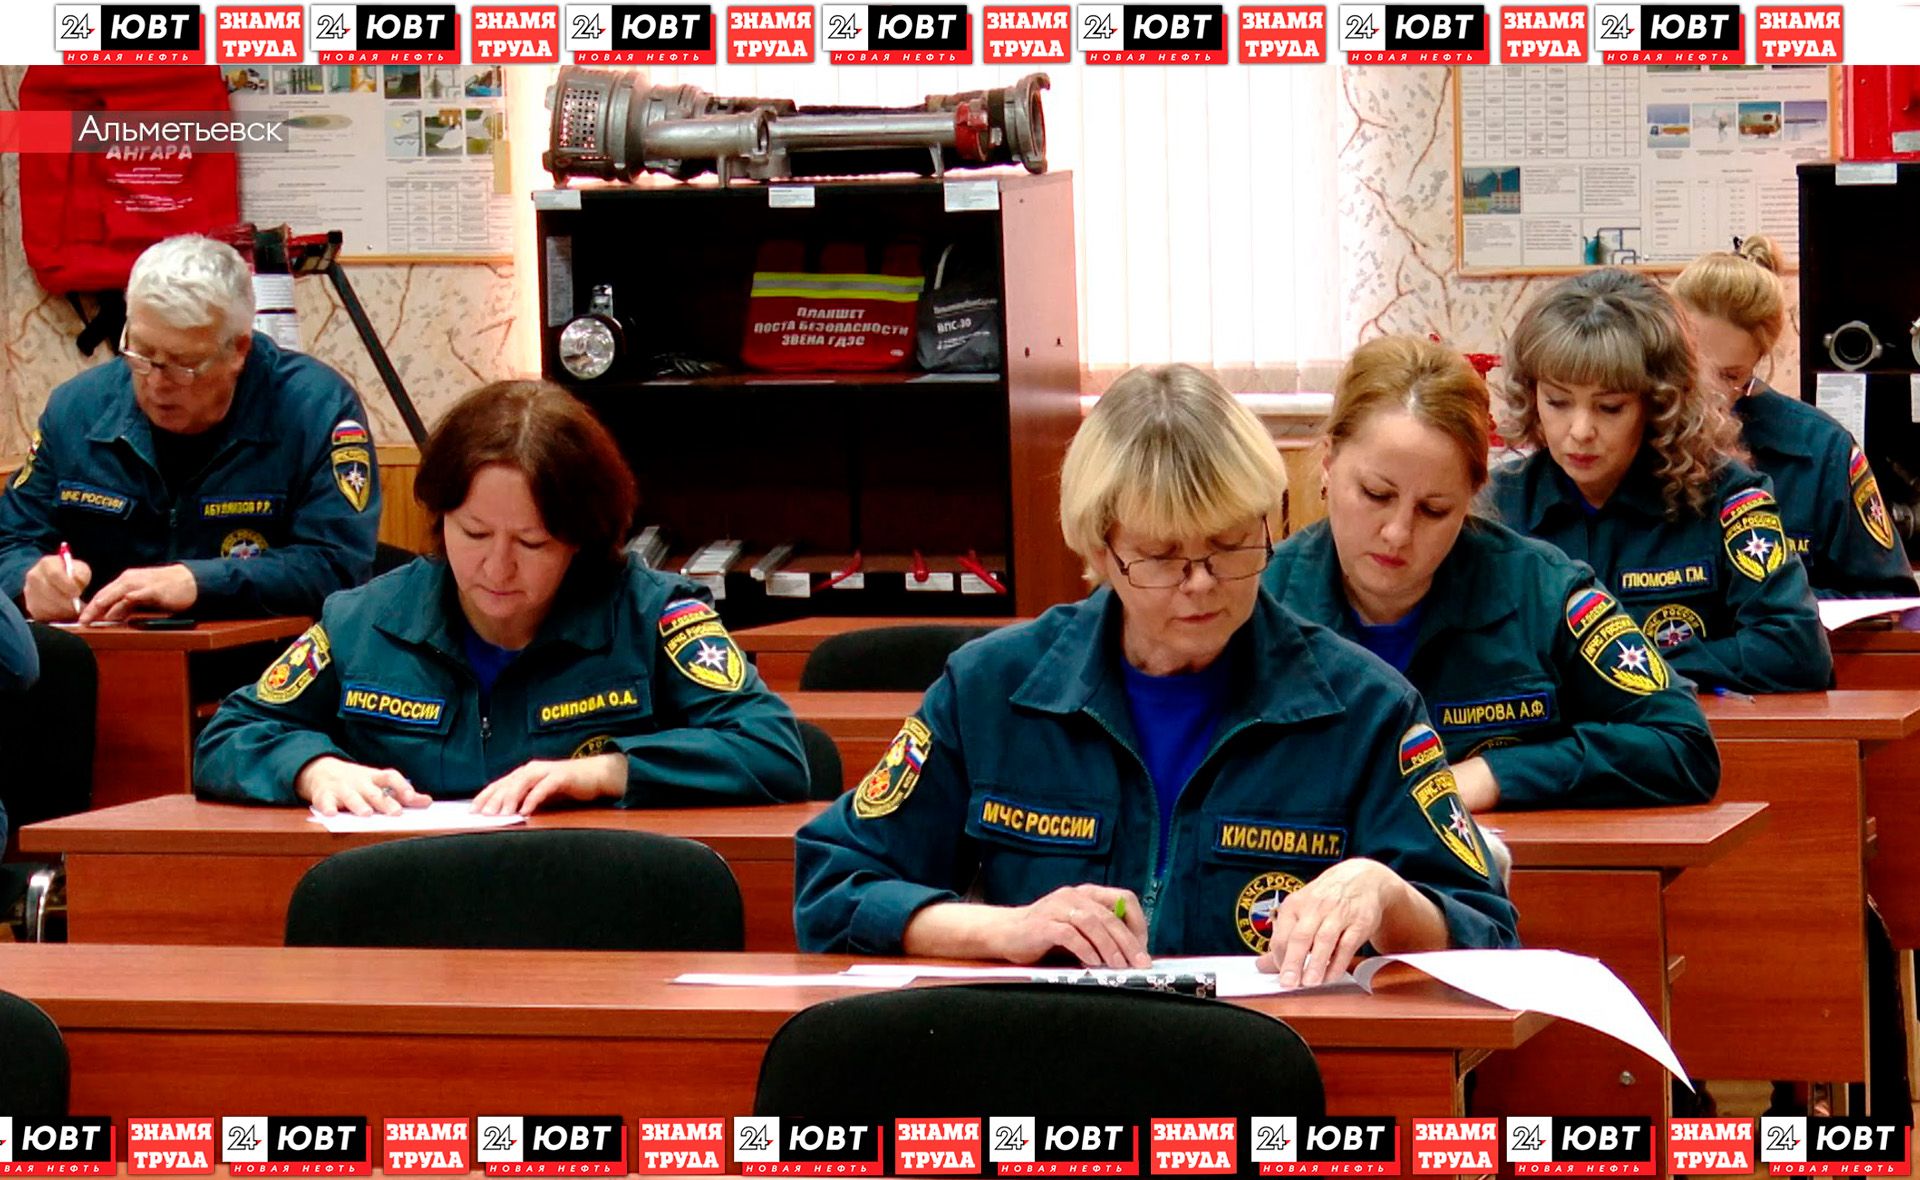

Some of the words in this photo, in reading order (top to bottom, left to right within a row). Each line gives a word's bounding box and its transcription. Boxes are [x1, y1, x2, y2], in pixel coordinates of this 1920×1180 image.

[106, 144, 193, 162] АНГАРА
[797, 307, 866, 319] ПЛАНШЕТ
[754, 320, 796, 334] ПОСТА
[798, 320, 909, 336] БЕЗОПАСНОСТИ
[781, 334, 825, 346] ЗВЕНА
[1622, 570, 1683, 589] ГЛЮМОВА
[345, 690, 378, 711] МЧС
[378, 696, 441, 720] РОССИИ
[541, 694, 605, 722] ОСИПОВА
[608, 689, 638, 705] О.А.
[1443, 700, 1516, 725] АШИРОВА
[1519, 699, 1546, 719] А.Ф.
[982, 800, 1025, 830] МЧС
[1025, 812, 1096, 840] РОССИИ
[1221, 825, 1308, 854] КИСЛОВА
[1311, 834, 1340, 856] Н.Т.
